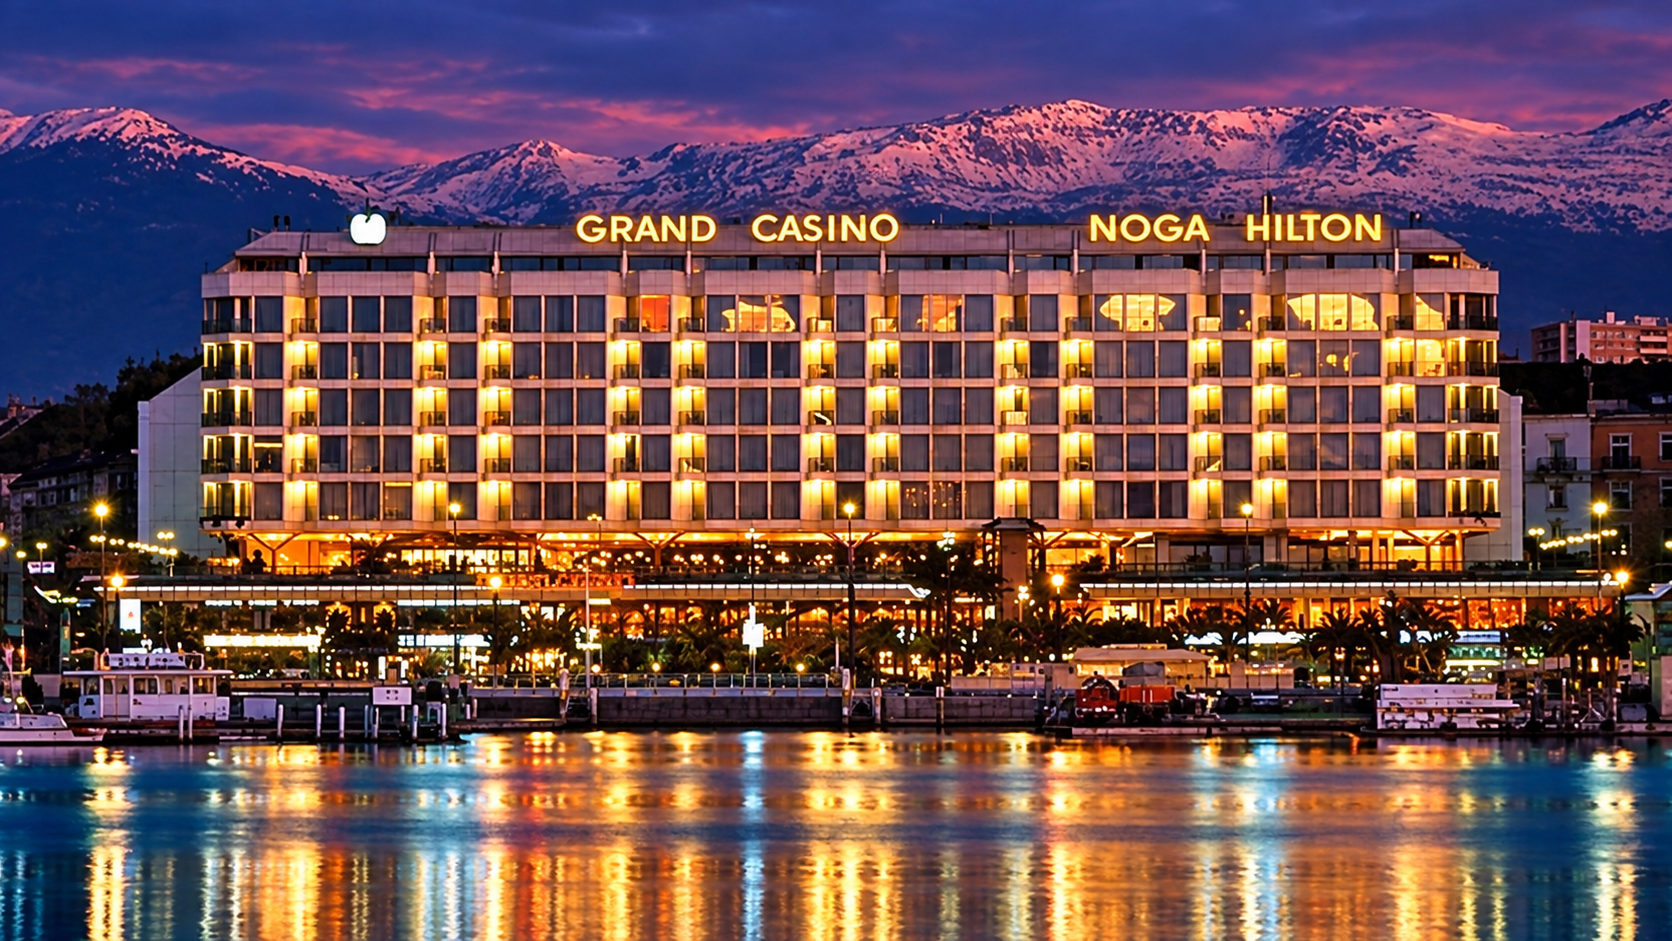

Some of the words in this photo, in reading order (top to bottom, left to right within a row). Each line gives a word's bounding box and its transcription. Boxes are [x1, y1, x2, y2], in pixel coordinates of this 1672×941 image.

[575, 213, 717, 243] GRAND
[751, 213, 899, 243] CASINO
[1089, 213, 1210, 242] NOGA
[1246, 213, 1383, 242] HILTON
